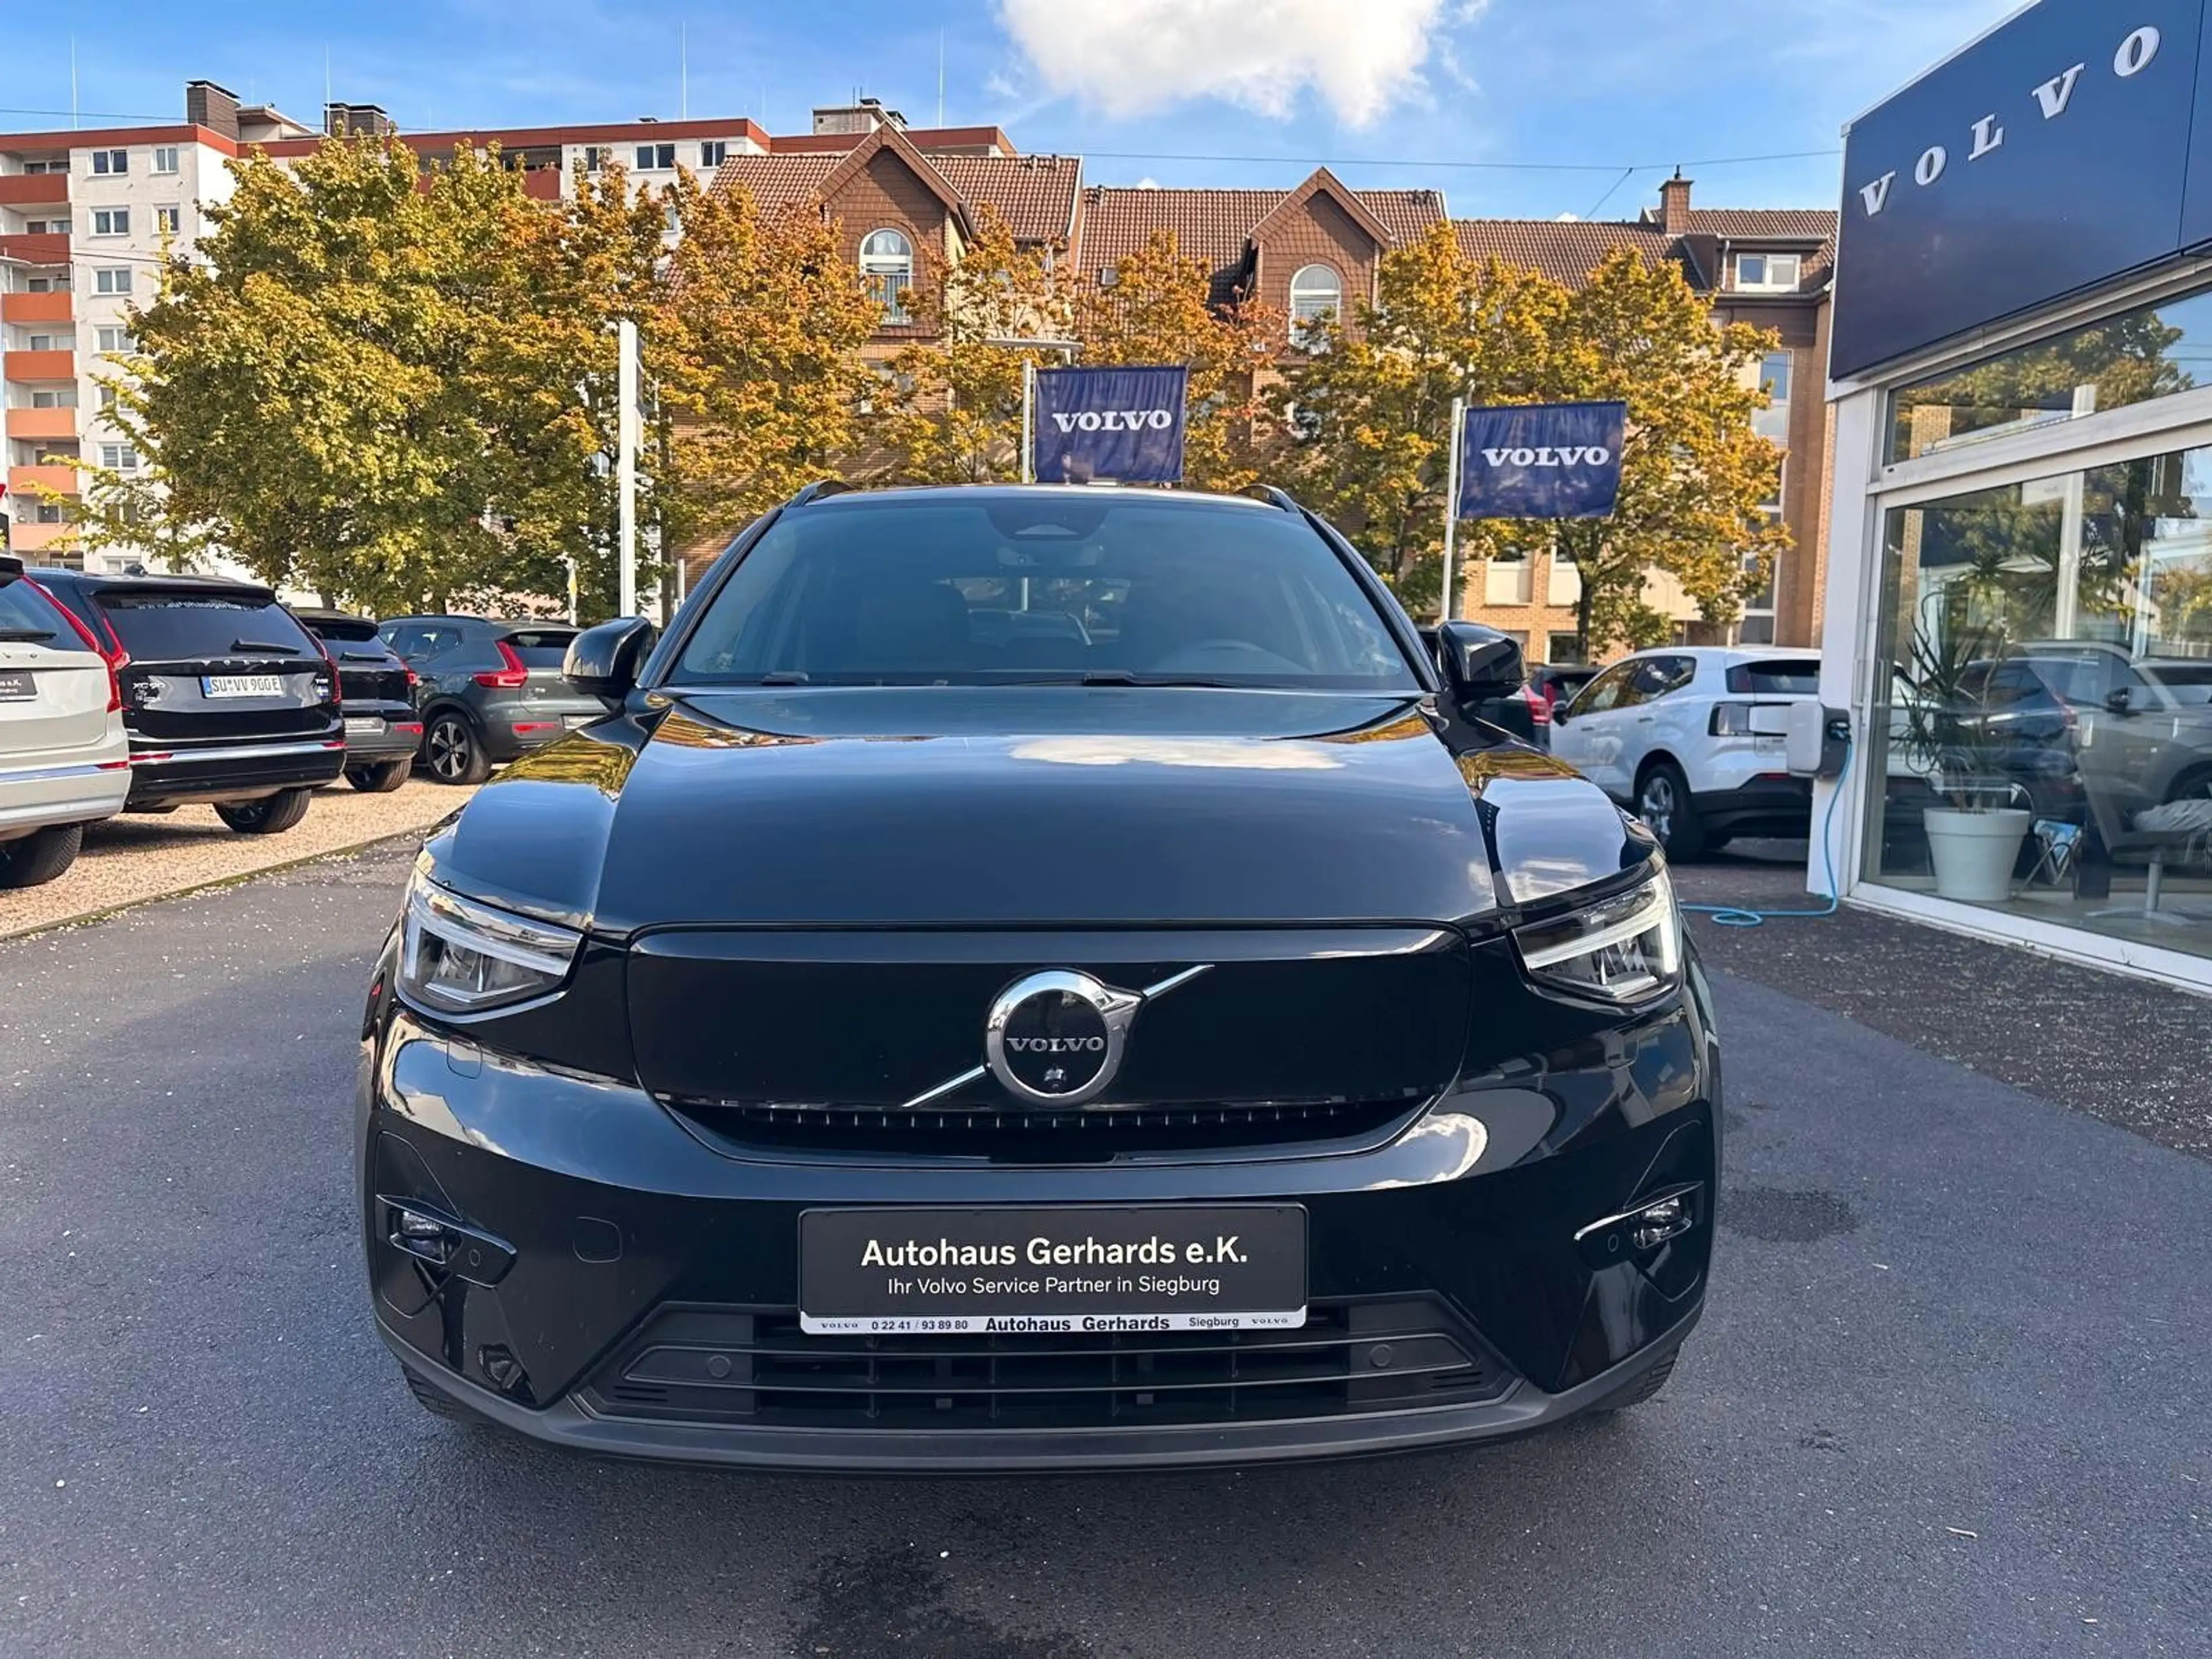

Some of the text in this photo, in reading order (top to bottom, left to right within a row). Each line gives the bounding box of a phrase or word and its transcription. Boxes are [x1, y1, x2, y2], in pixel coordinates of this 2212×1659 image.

[1859, 26, 2160, 217] VOLVO
[1052, 409, 1172, 433] VOLVO
[1482, 446, 1609, 467] VOLVO
[211, 679, 228, 692] SU
[234, 678, 248, 691] VV
[1006, 1037, 1104, 1052] VOLVO
[861, 1236, 1248, 1266] Autohaus Gerhards e.K.
[888, 1275, 1219, 1296] Ihr Volvo Service Partner in Siegburg
[872, 1321, 878, 1330] 0
[881, 1321, 895, 1330] 22
[898, 1321, 911, 1330] 41
[922, 1320, 934, 1330] 93
[939, 1320, 951, 1330] 89
[955, 1320, 968, 1330] 80
[986, 1317, 1071, 1331] Autohaus
[1082, 1316, 1170, 1330] Gerhards
[1189, 1317, 1239, 1328] Siegburg
